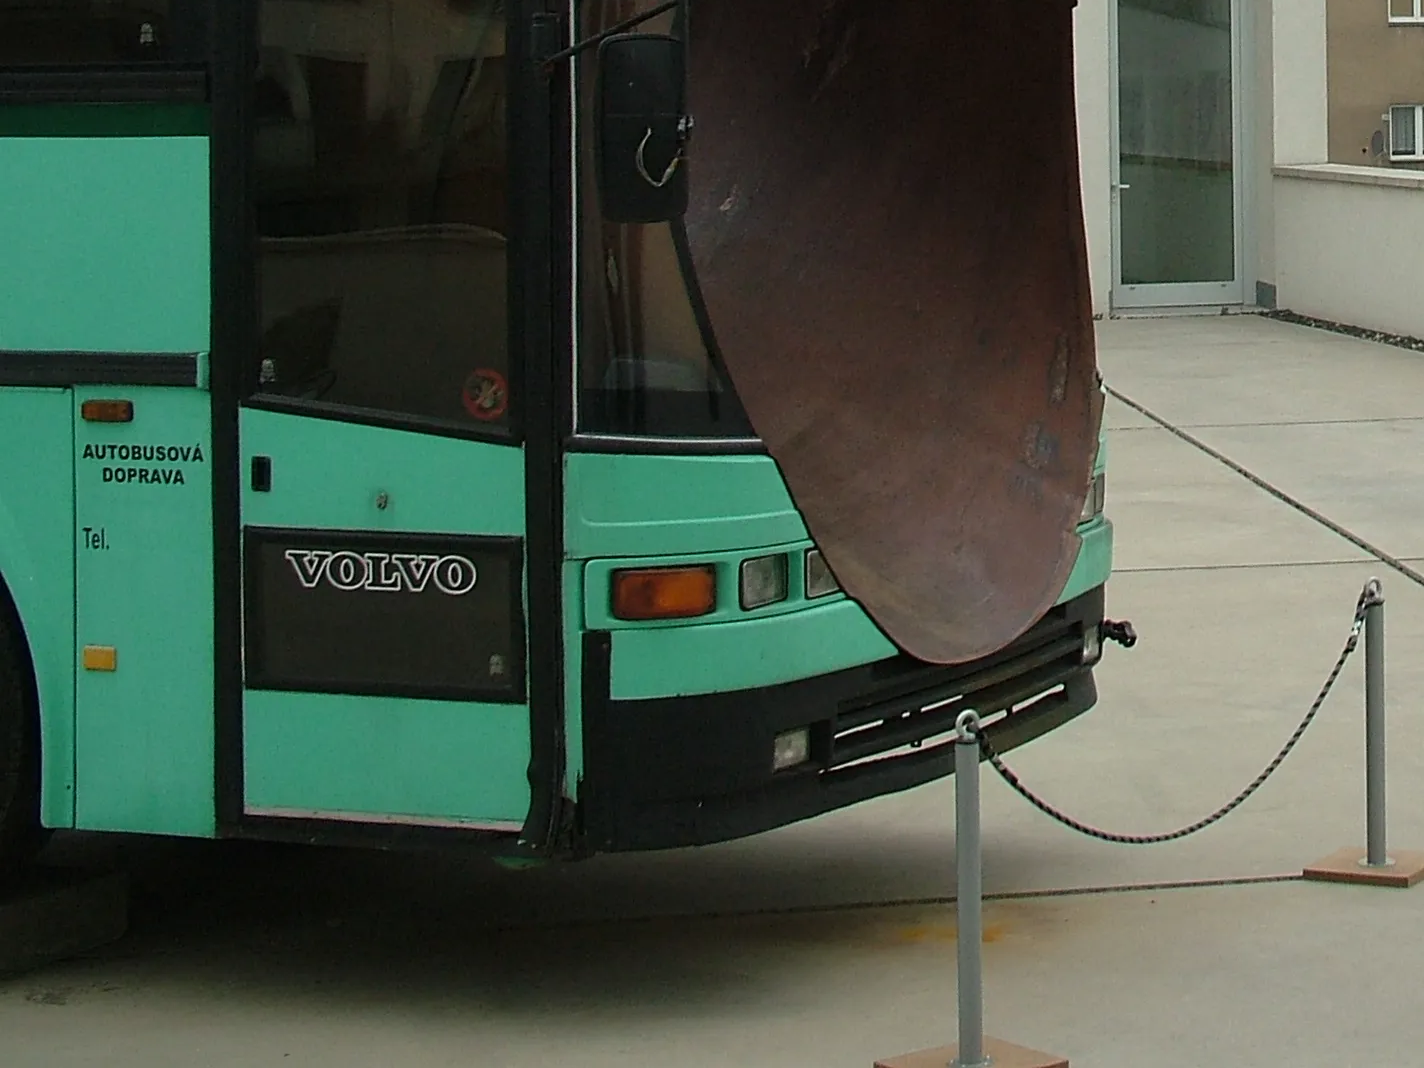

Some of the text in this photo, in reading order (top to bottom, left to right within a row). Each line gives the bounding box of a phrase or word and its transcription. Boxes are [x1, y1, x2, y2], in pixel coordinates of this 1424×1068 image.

[82, 442, 204, 462] AUTOBUSOVÁ
[102, 467, 185, 485] DOPRAVA
[82, 527, 110, 550] Tel.
[285, 550, 477, 595] VOLVO
